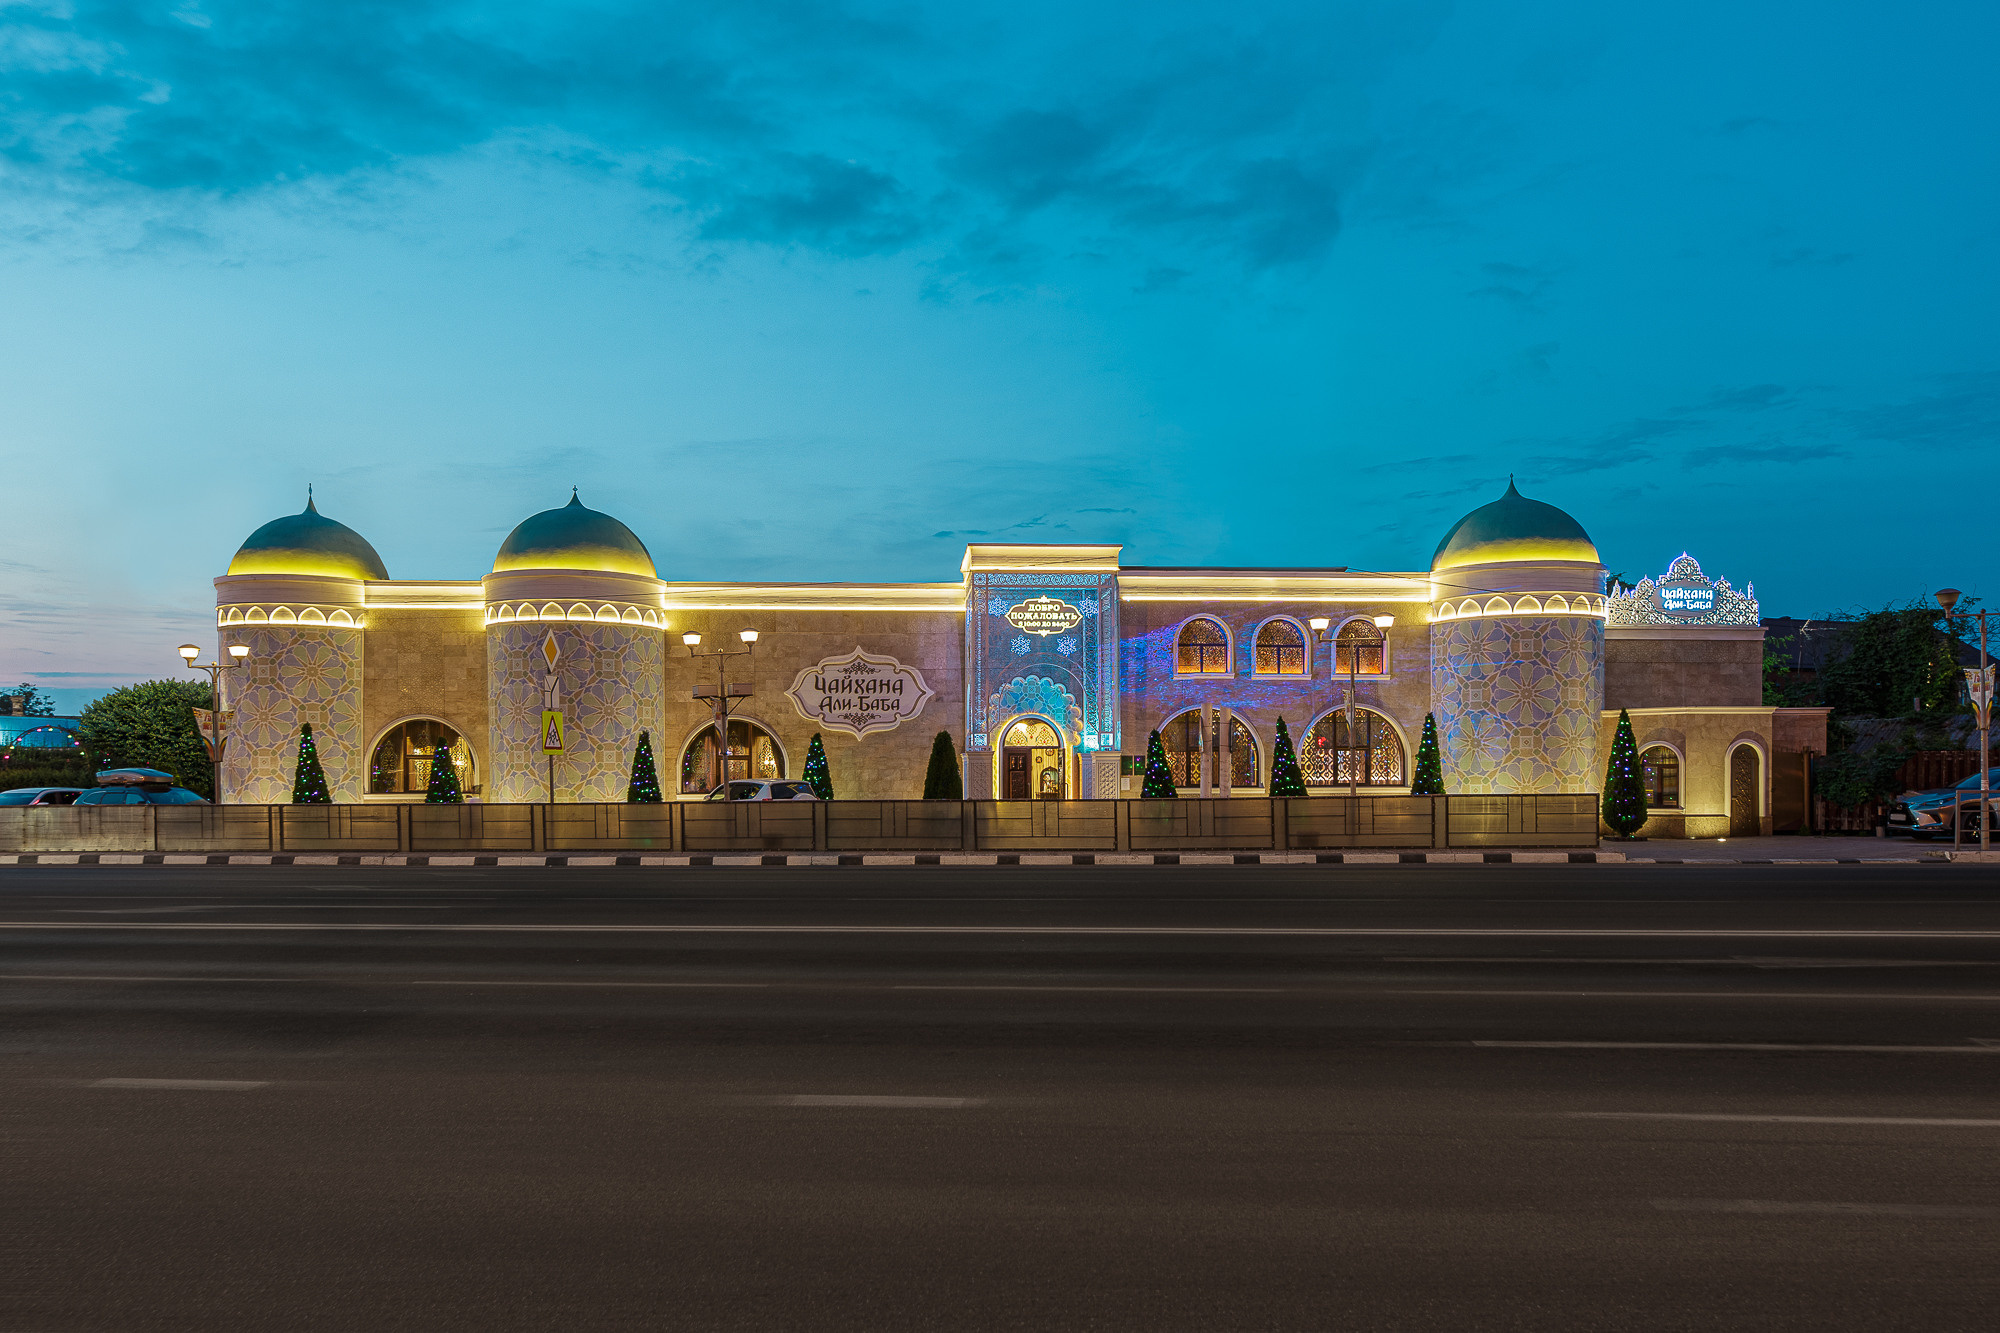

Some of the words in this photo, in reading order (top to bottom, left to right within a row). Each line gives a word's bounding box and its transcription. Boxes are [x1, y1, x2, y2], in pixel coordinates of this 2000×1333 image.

[1028, 604, 1060, 612] ДОБРО
[1011, 612, 1077, 620] ПОЖАЛОВАТЬ
[814, 675, 904, 696] ЧАЙХАНА
[818, 696, 900, 713] Али-Баба
